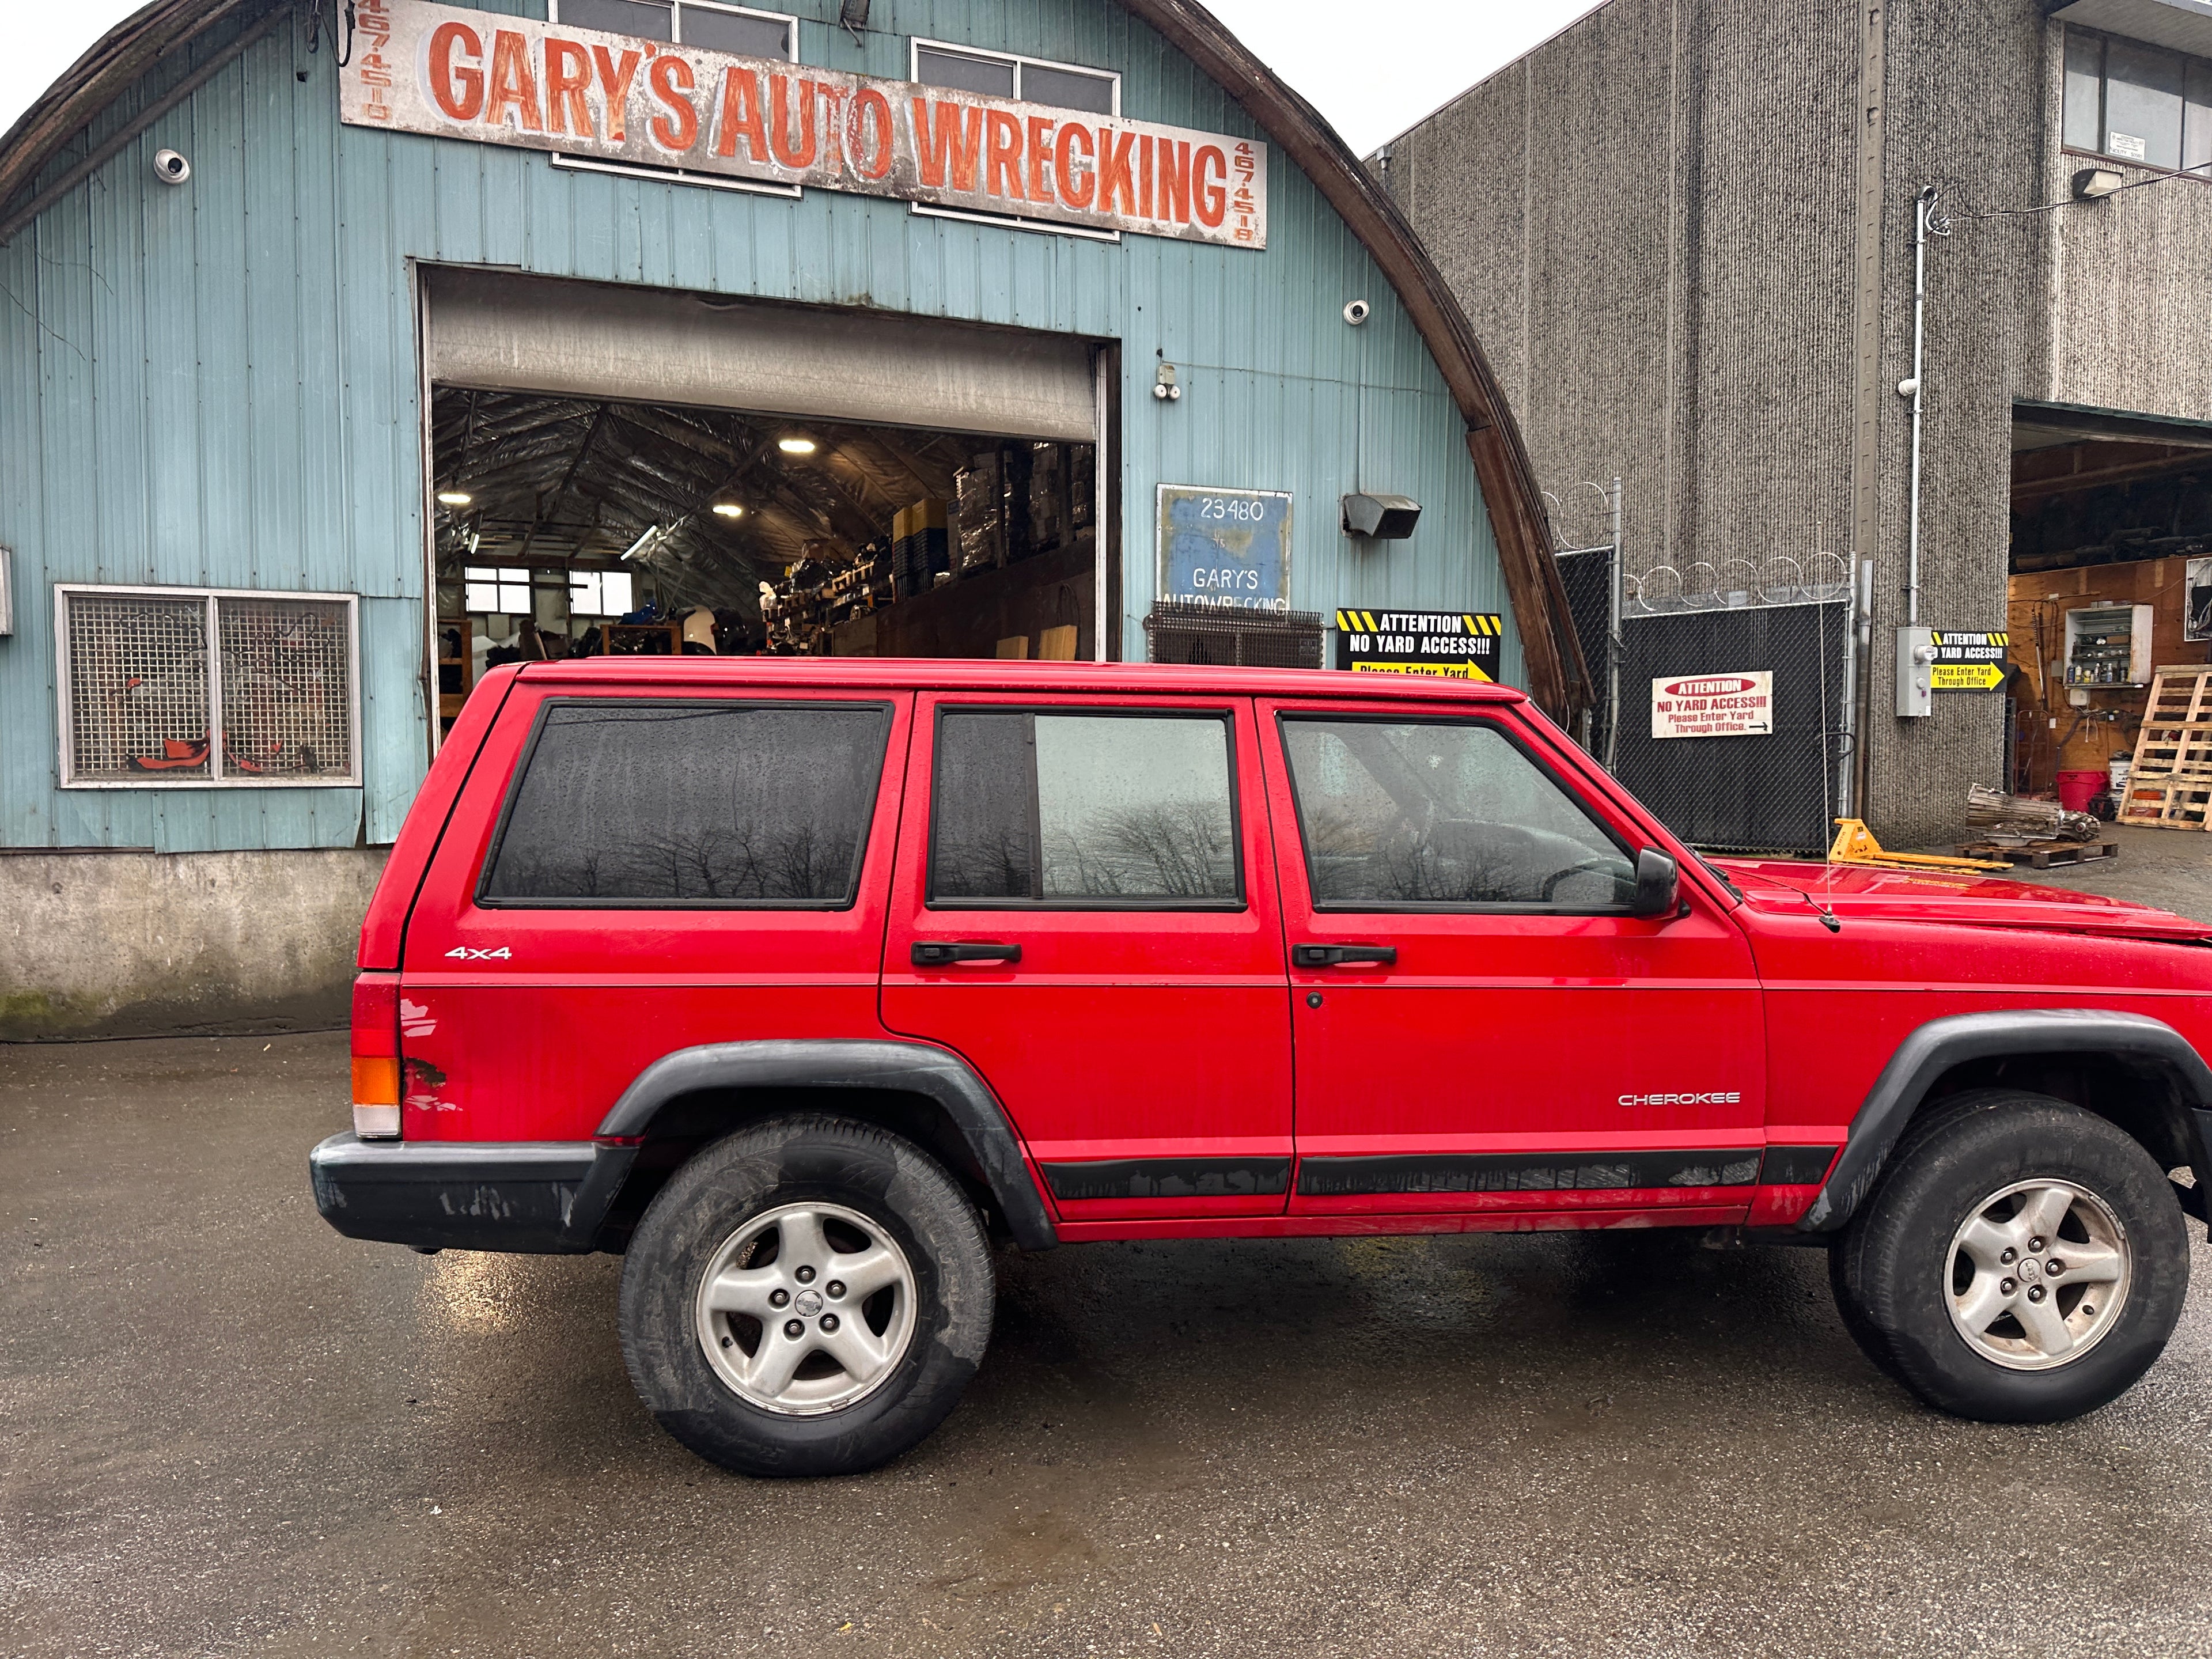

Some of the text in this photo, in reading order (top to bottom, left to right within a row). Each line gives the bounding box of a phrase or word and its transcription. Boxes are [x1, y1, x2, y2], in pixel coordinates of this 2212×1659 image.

[429, 21, 1227, 228] GARY'S AUTO WRECKING
[1200, 498, 1264, 521] 23480
[1193, 568, 1258, 590] GARY'S
[1380, 613, 1461, 634] ATTENTION
[1350, 634, 1490, 655] NO YARD ACCESS!!!
[1942, 633, 1987, 645] ATTENTION
[1941, 647, 1962, 659] YARD
[1964, 647, 2003, 659] ACCESS!!!
[1933, 666, 1991, 676] Please Enter Yard
[1677, 679, 1742, 695] ATTENTION
[1938, 677, 1986, 687] Through Office
[1657, 696, 1767, 713] NO YARD ACCESS!!!
[1668, 710, 1754, 723] Please Enter Yard
[1675, 724, 1713, 733] Through
[444, 946, 513, 960] 4x4
[1618, 1092, 1741, 1106] CHEROKEE
